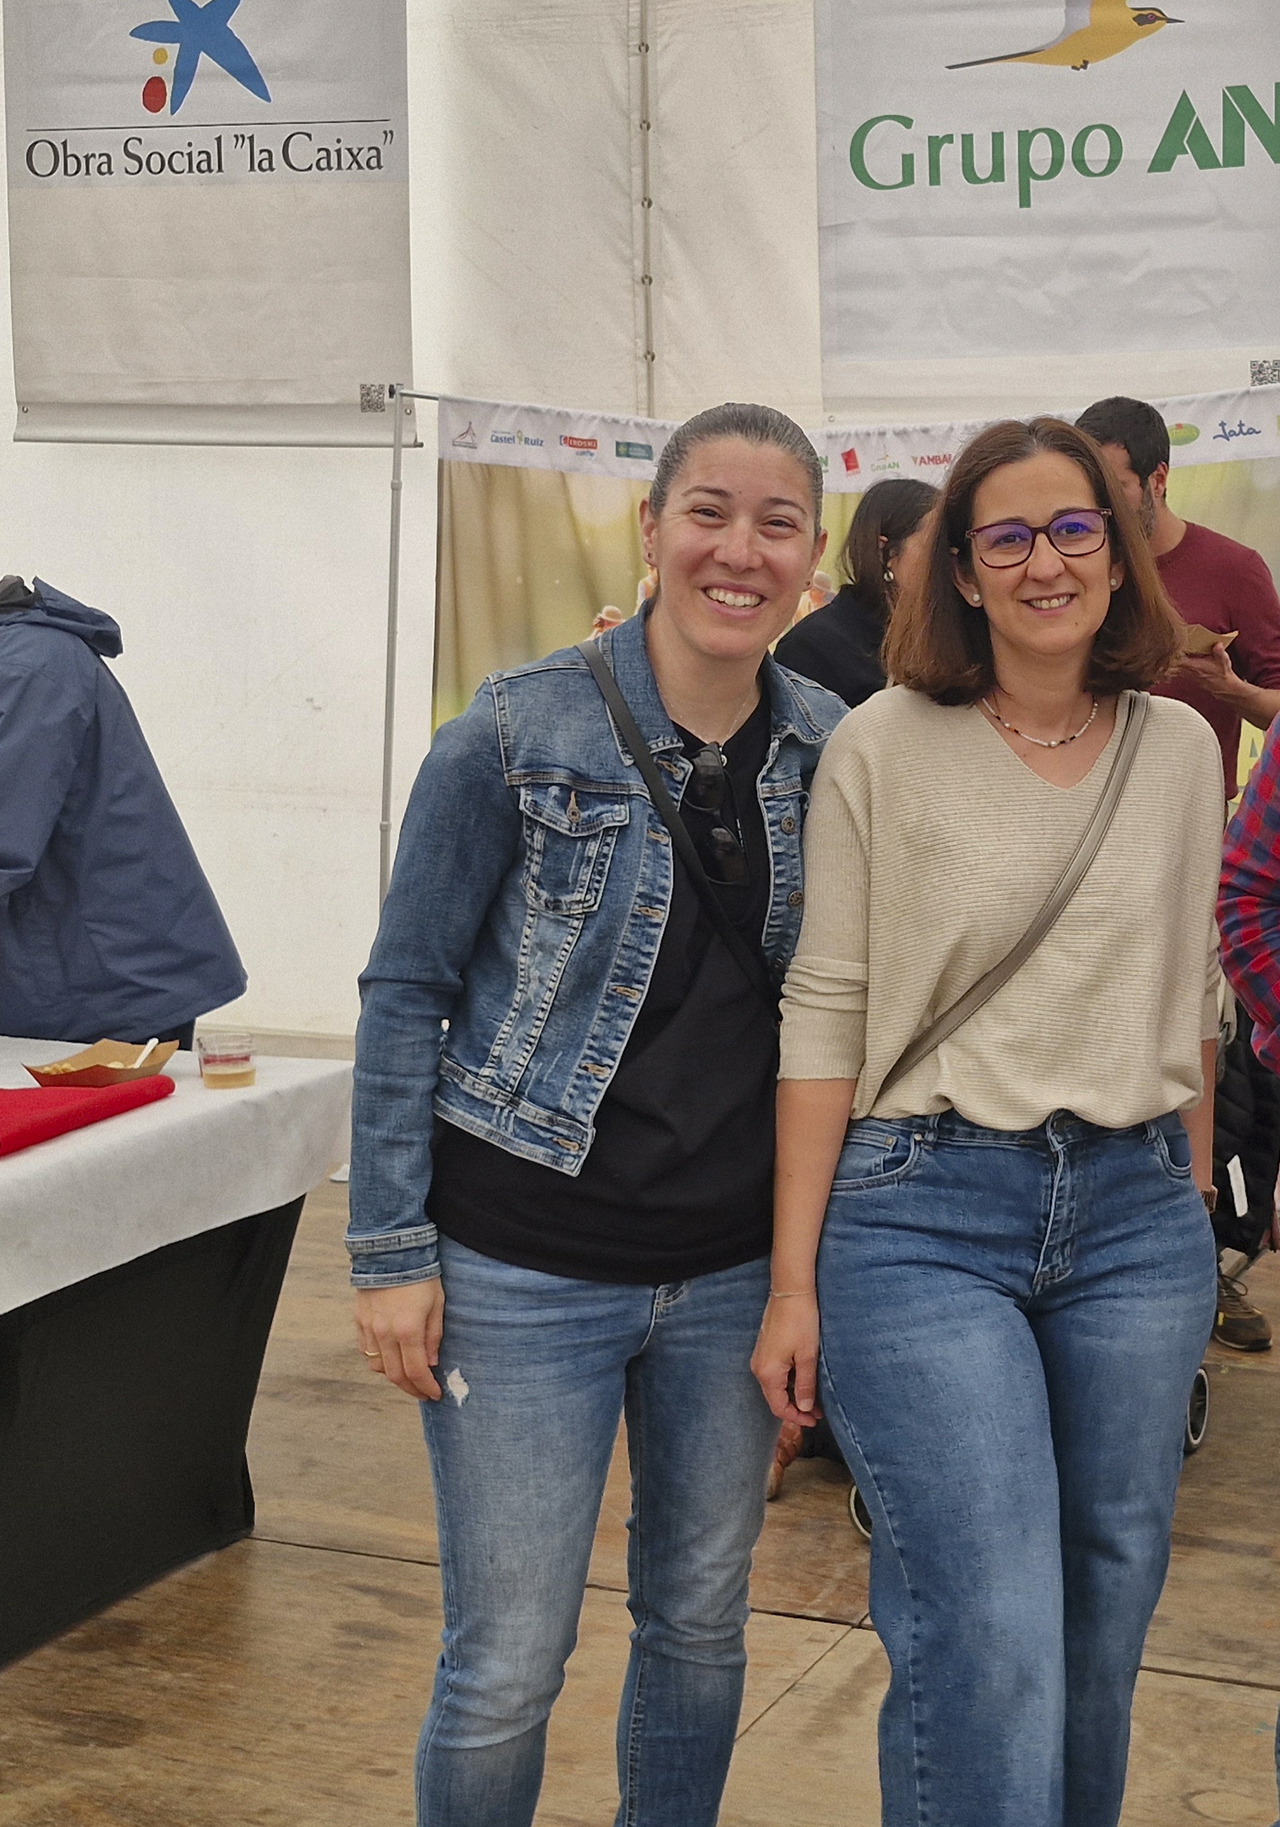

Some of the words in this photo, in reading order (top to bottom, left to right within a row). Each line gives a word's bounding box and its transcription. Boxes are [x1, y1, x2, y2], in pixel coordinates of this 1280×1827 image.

[25, 138, 114, 178] Obra
[123, 134, 224, 176] Social
[849, 114, 1124, 208] Grupo
